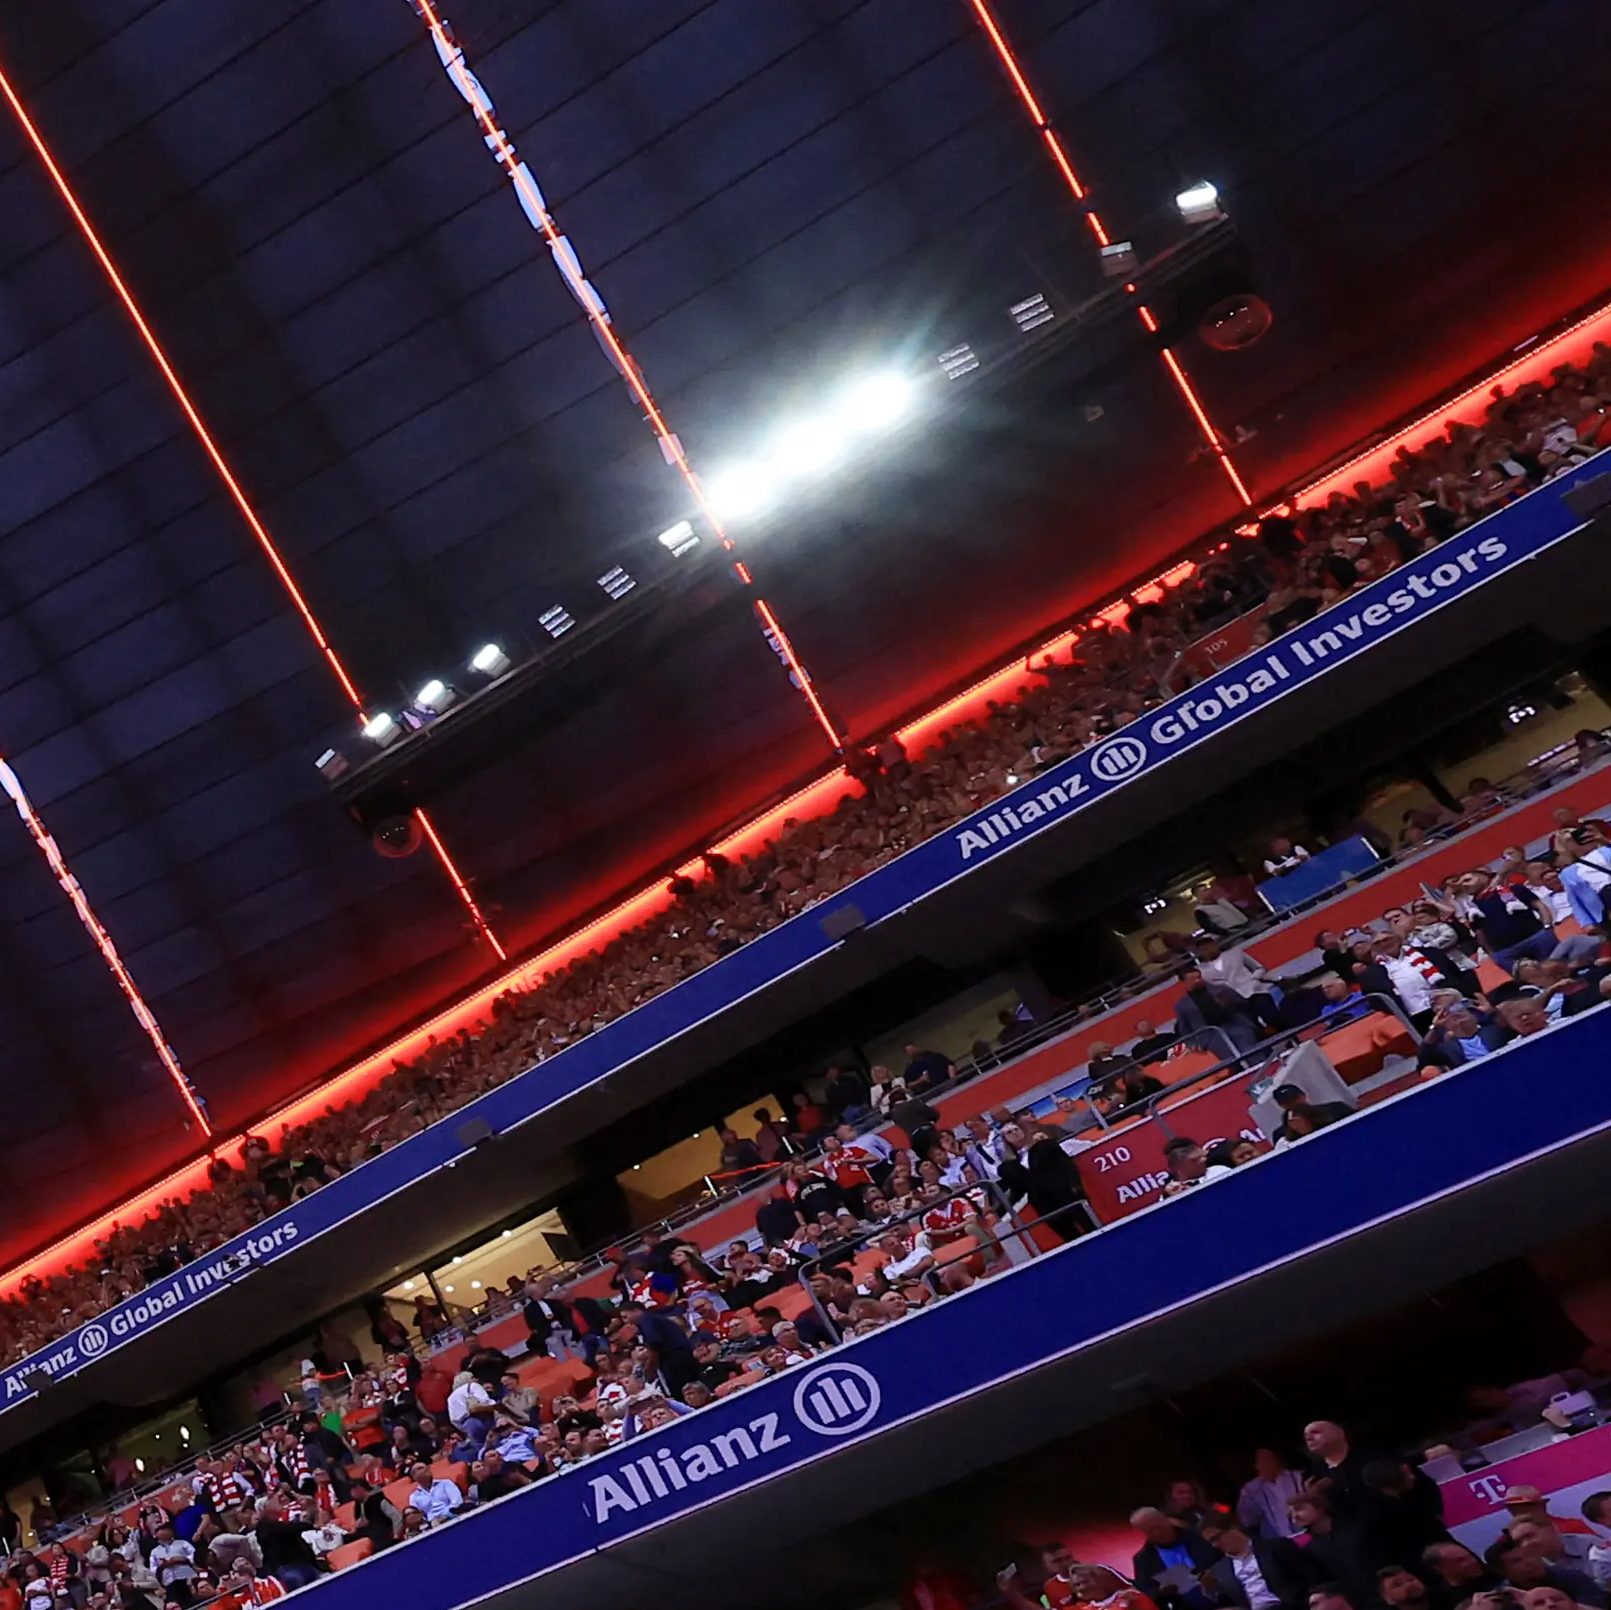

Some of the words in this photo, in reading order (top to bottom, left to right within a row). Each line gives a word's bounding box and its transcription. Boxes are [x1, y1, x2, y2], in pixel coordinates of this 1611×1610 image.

[956, 771, 1090, 860] Allianz
[1150, 655, 1291, 746] Global
[1291, 533, 1509, 667] Investors
[1093, 1146, 1131, 1173] 210
[1115, 1170, 1172, 1204] Allia
[110, 1281, 184, 1336] Global
[587, 1411, 792, 1525] Allianz
[1466, 1474, 1505, 1505] T
